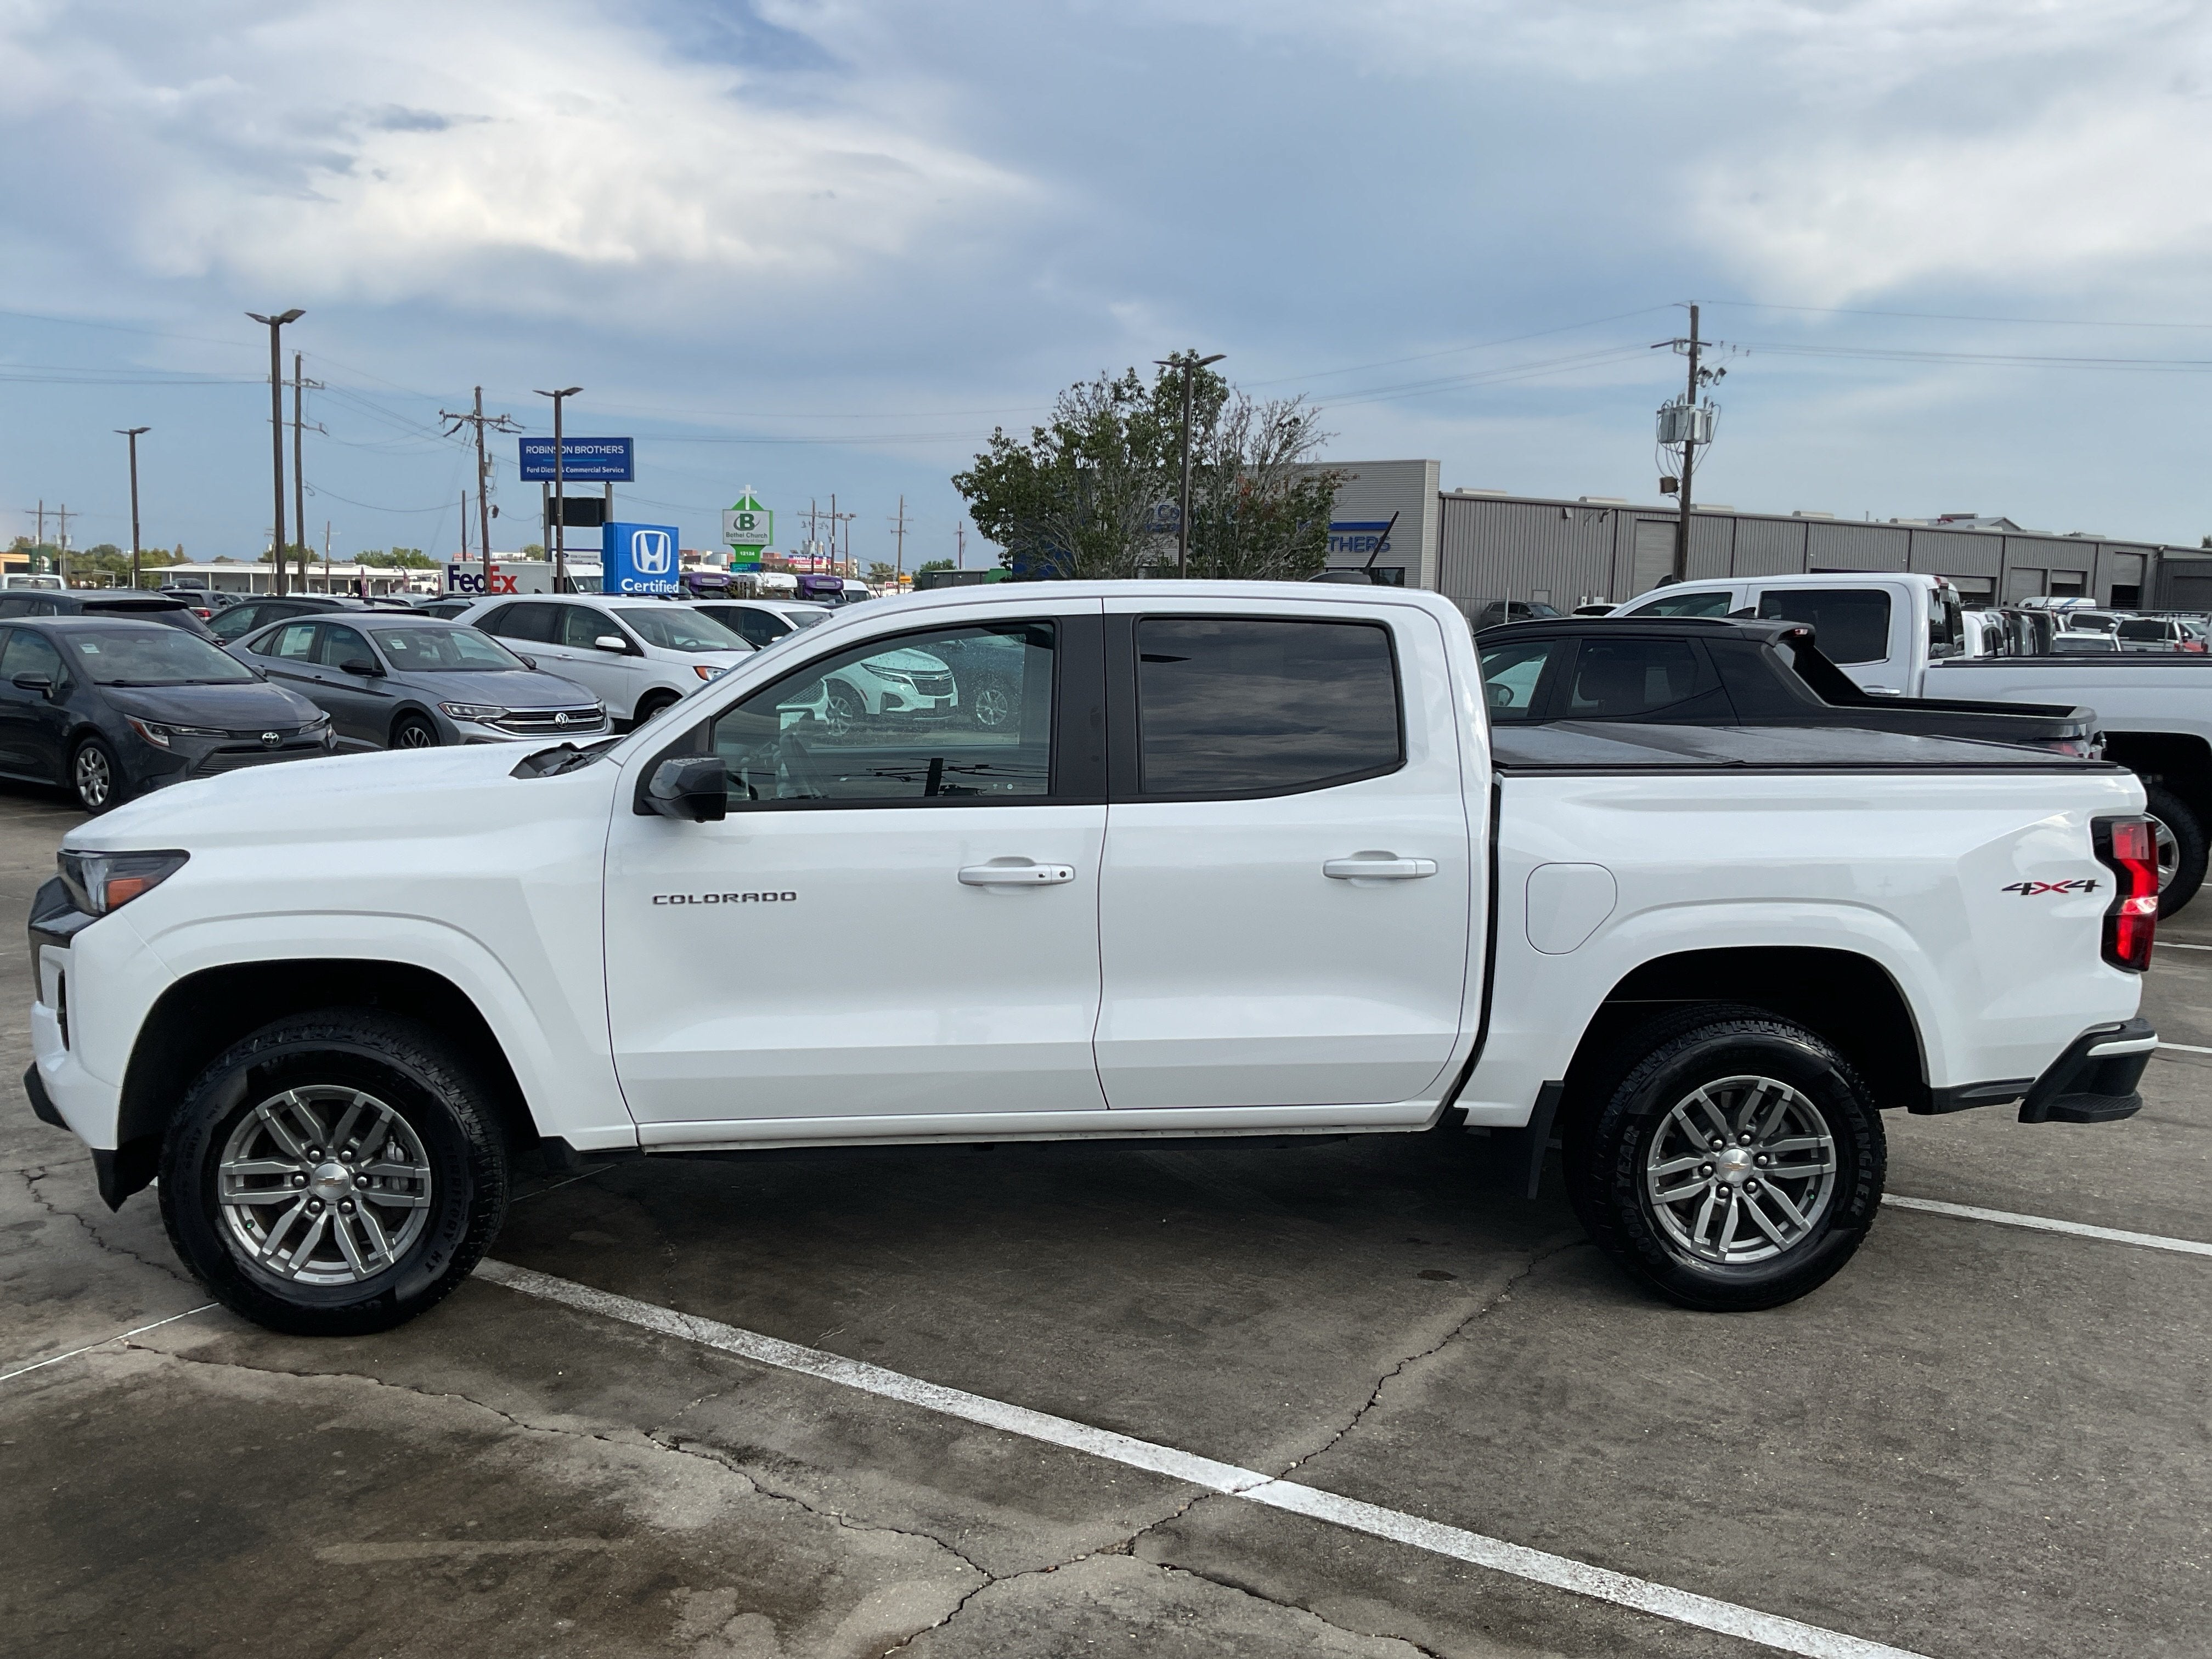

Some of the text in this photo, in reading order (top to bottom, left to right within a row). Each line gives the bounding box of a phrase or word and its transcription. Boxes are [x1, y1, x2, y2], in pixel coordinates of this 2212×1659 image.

[574, 445, 624, 454] BROTHERS
[1328, 535, 1391, 553] THERS
[448, 565, 518, 593] FedEx
[621, 578, 679, 593] Certified
[652, 891, 797, 905] COLORADO
